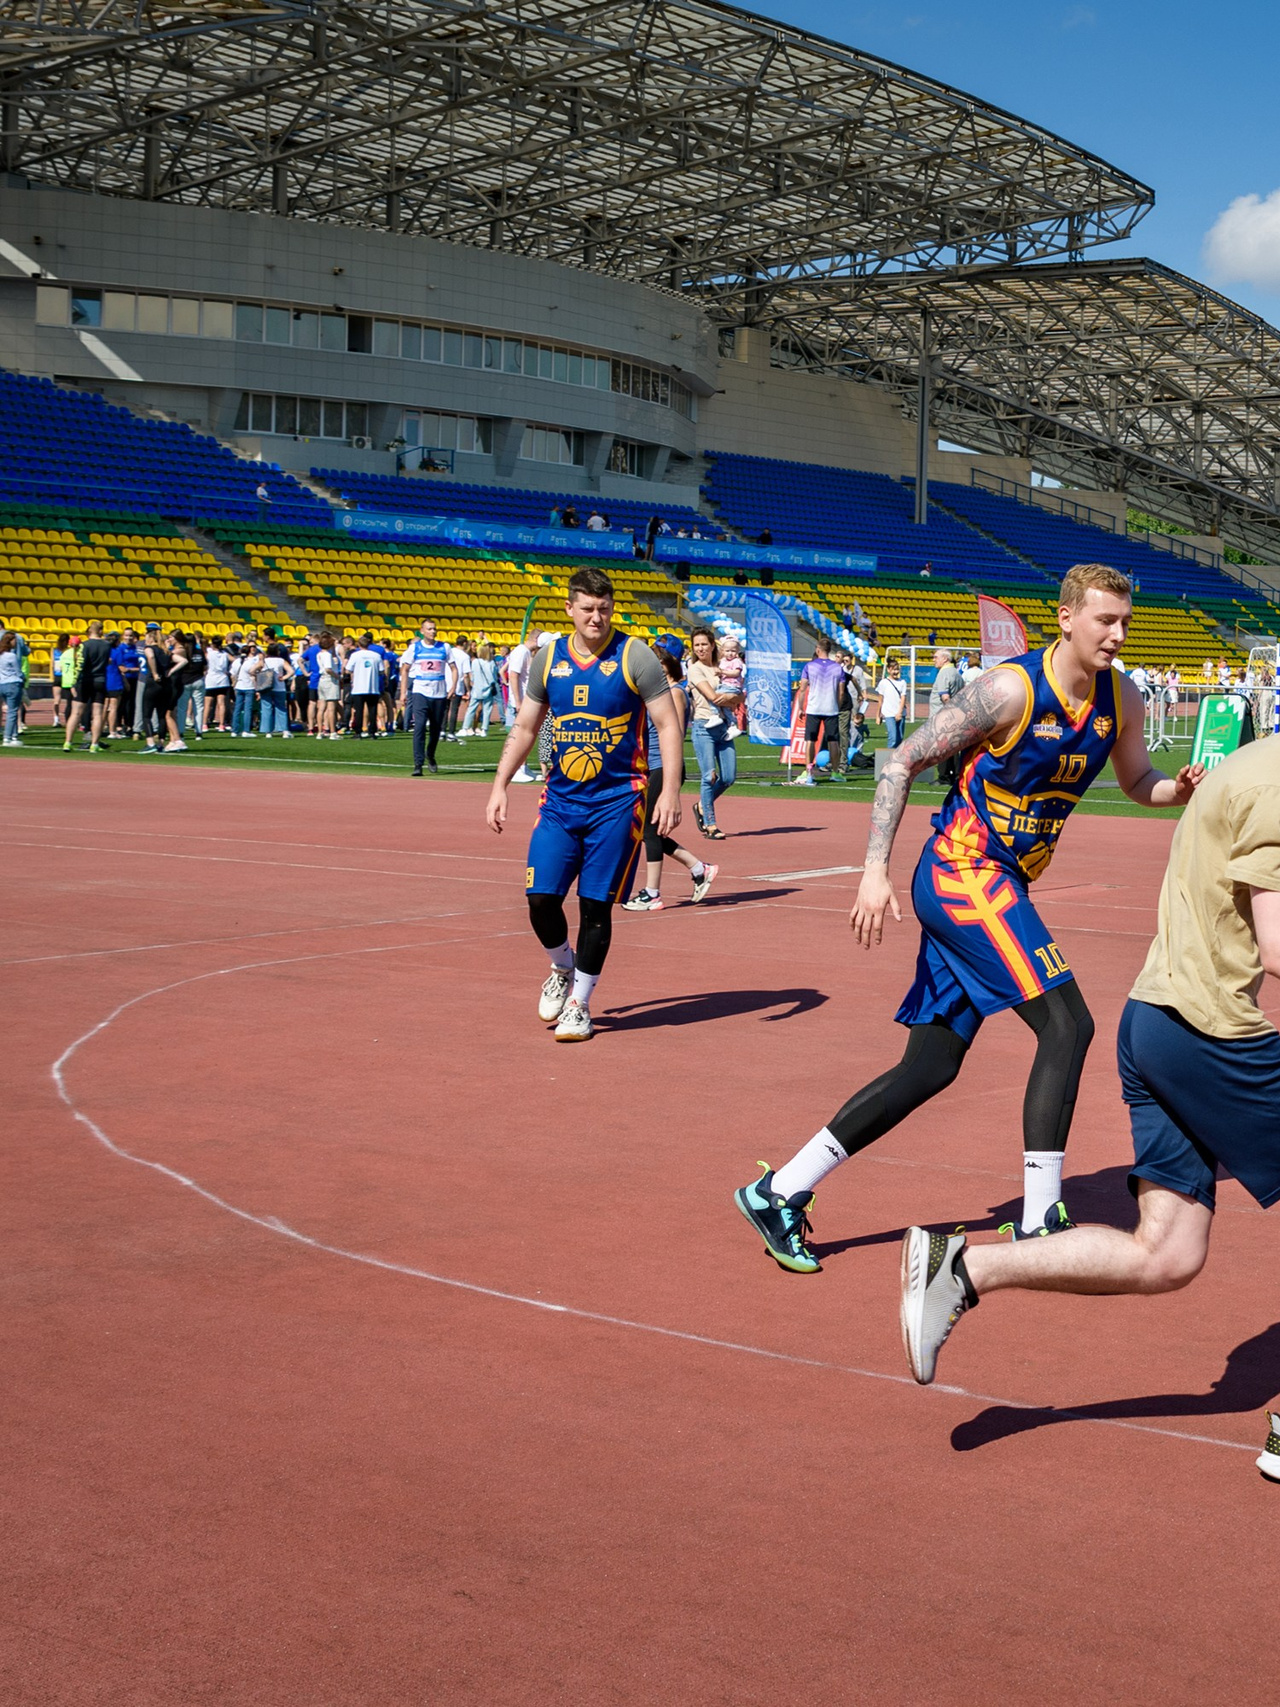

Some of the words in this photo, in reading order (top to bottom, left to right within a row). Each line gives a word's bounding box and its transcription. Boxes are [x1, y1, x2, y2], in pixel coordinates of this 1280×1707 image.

[426, 660, 434, 670] 2
[573, 684, 589, 706] 8
[555, 731, 610, 743] ЛЕГЕНДА
[1050, 754, 1088, 783] 10
[1012, 814, 1065, 835] ЛЕГЕН
